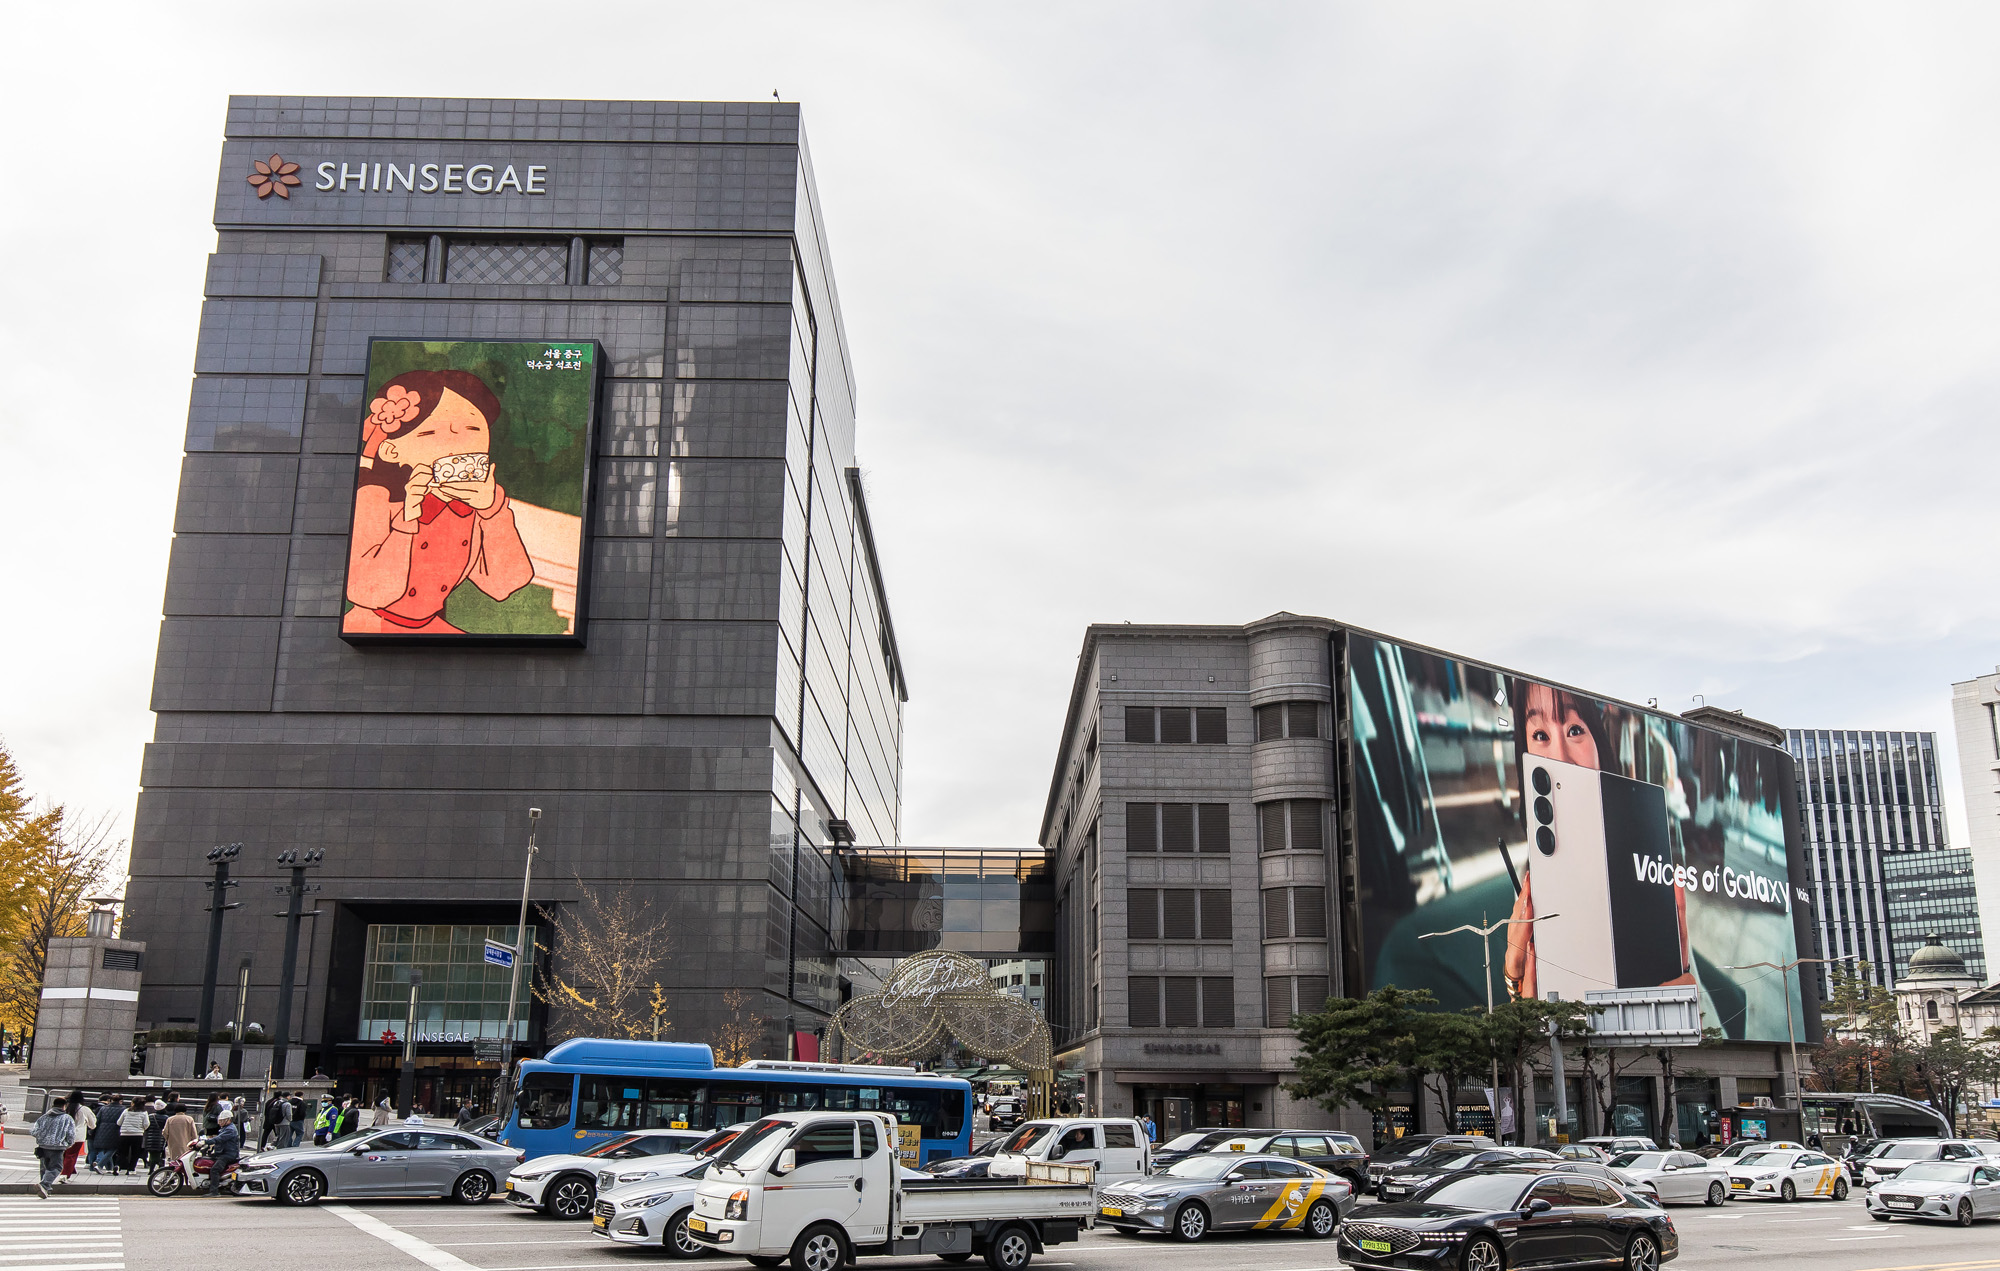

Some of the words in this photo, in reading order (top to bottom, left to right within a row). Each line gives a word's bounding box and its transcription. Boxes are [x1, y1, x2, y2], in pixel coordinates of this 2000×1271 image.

[315, 161, 547, 194] SHINSEGAE
[543, 348, 562, 359] 서울
[564, 349, 582, 359] 중구
[526, 360, 554, 370] 덕수궁
[555, 360, 582, 371] 석조전
[1633, 853, 1699, 892] Voices
[1702, 865, 1720, 893] of
[1723, 866, 1790, 912] Galaxy
[917, 955, 954, 983] Joy
[882, 974, 985, 1008] Everywhere
[401, 1032, 470, 1042] SINSEGAE
[1143, 1043, 1222, 1055] SHINSEGAE
[1231, 1195, 1250, 1204] 카카오
[1251, 1195, 1256, 1203] T
